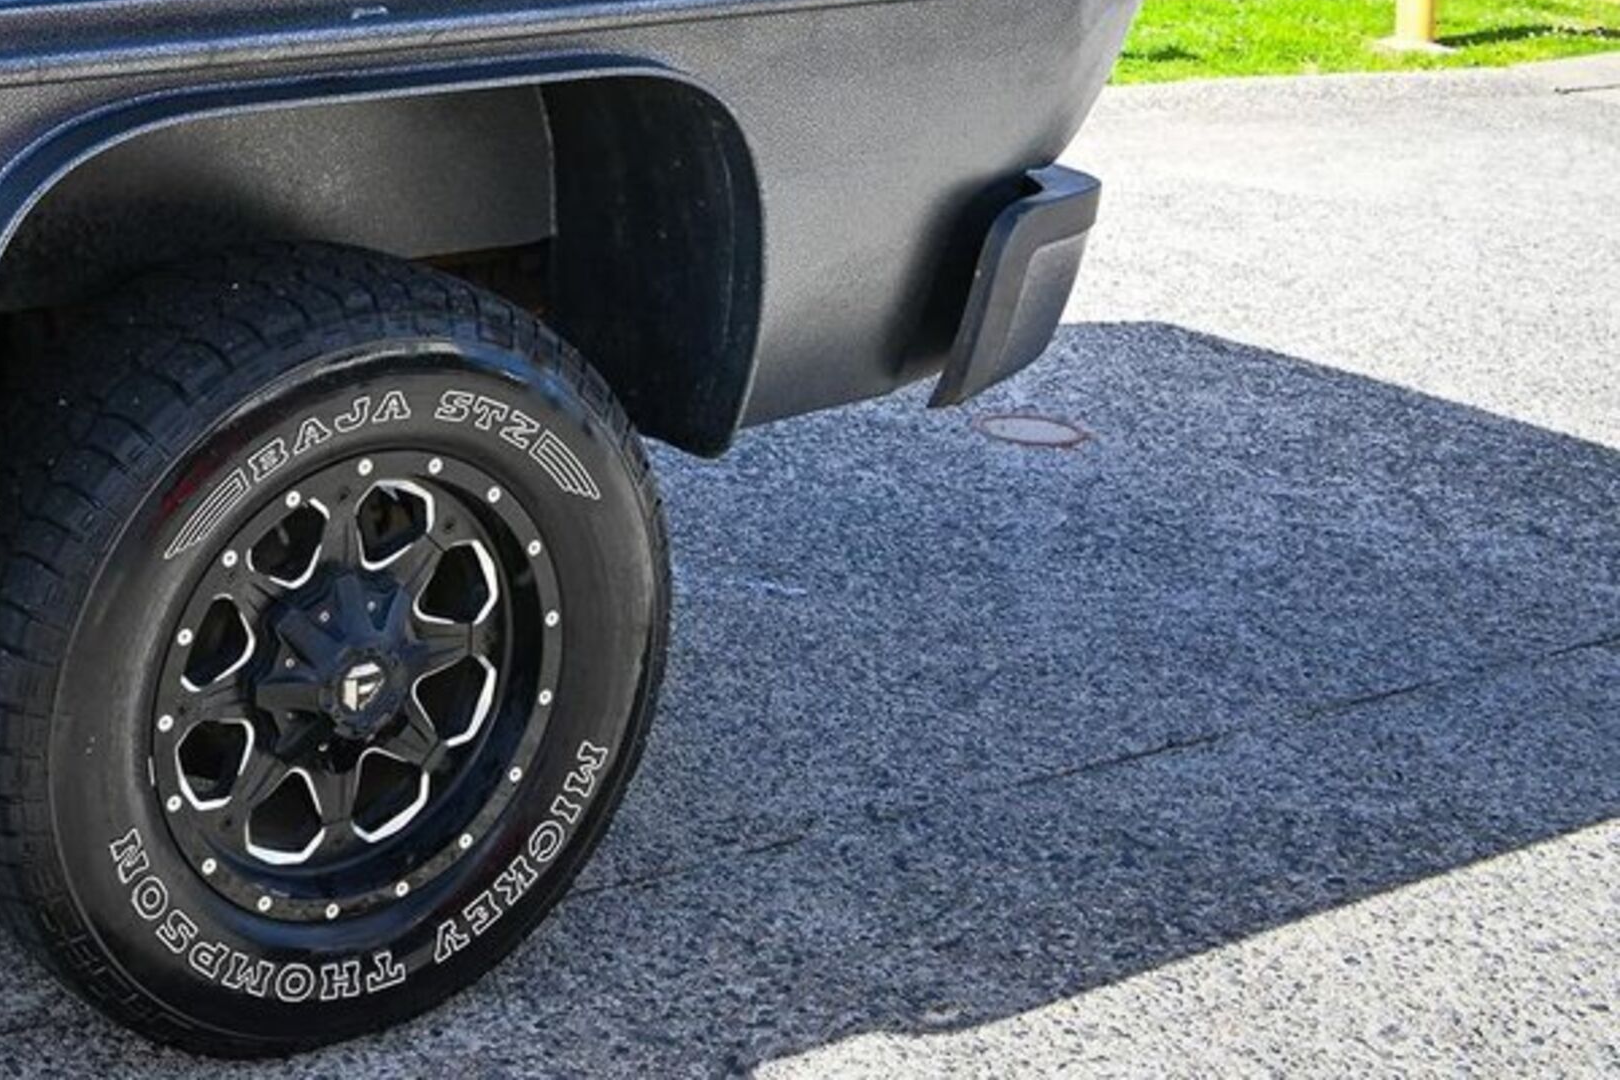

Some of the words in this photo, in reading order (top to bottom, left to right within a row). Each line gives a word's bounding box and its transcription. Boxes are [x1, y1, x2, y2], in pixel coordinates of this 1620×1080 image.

[248, 390, 412, 480] BAJA
[110, 828, 406, 1002] THOMPSON
[433, 741, 608, 963] MICKEY
